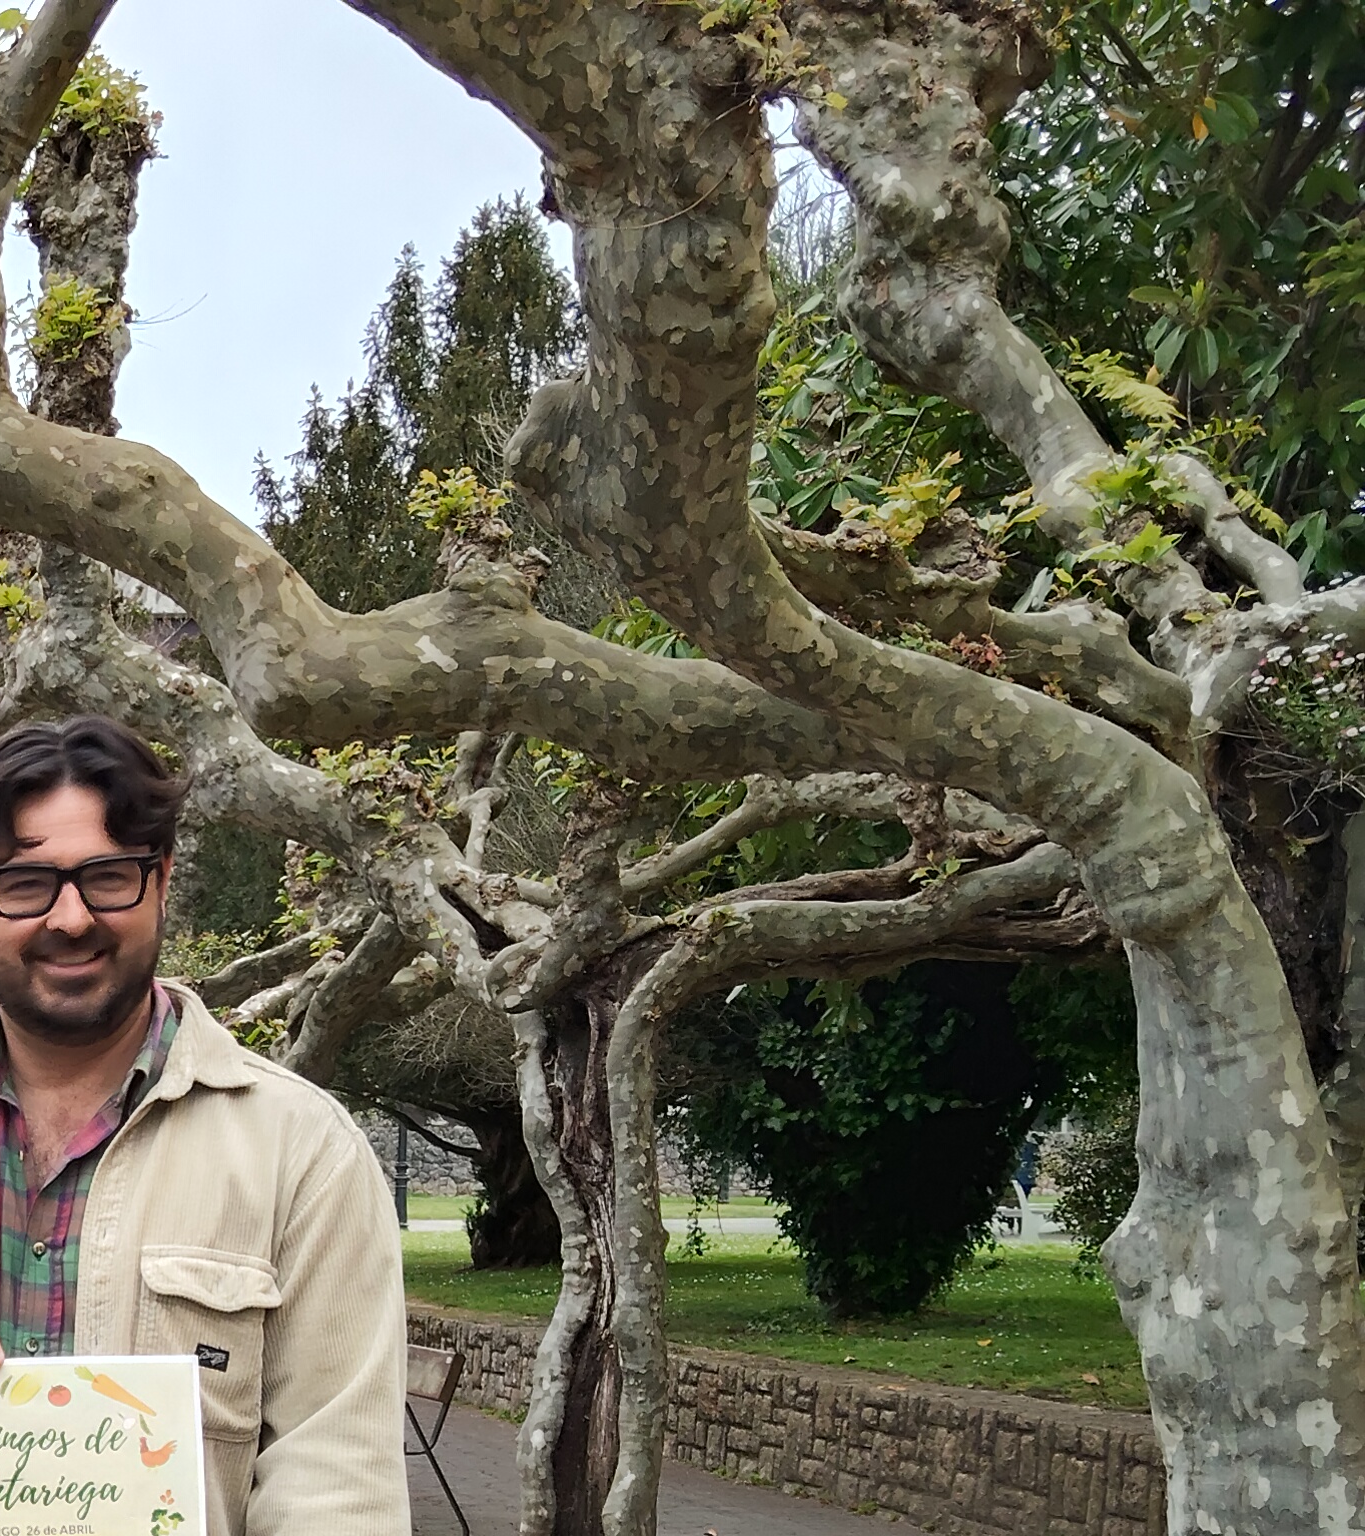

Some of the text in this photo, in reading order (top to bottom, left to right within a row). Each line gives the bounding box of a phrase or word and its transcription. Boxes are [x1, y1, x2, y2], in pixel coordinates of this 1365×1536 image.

[84, 1415, 128, 1454] de
[26, 1525, 40, 1536] 26
[43, 1525, 57, 1536] de
[59, 1524, 94, 1536] ABRIL
